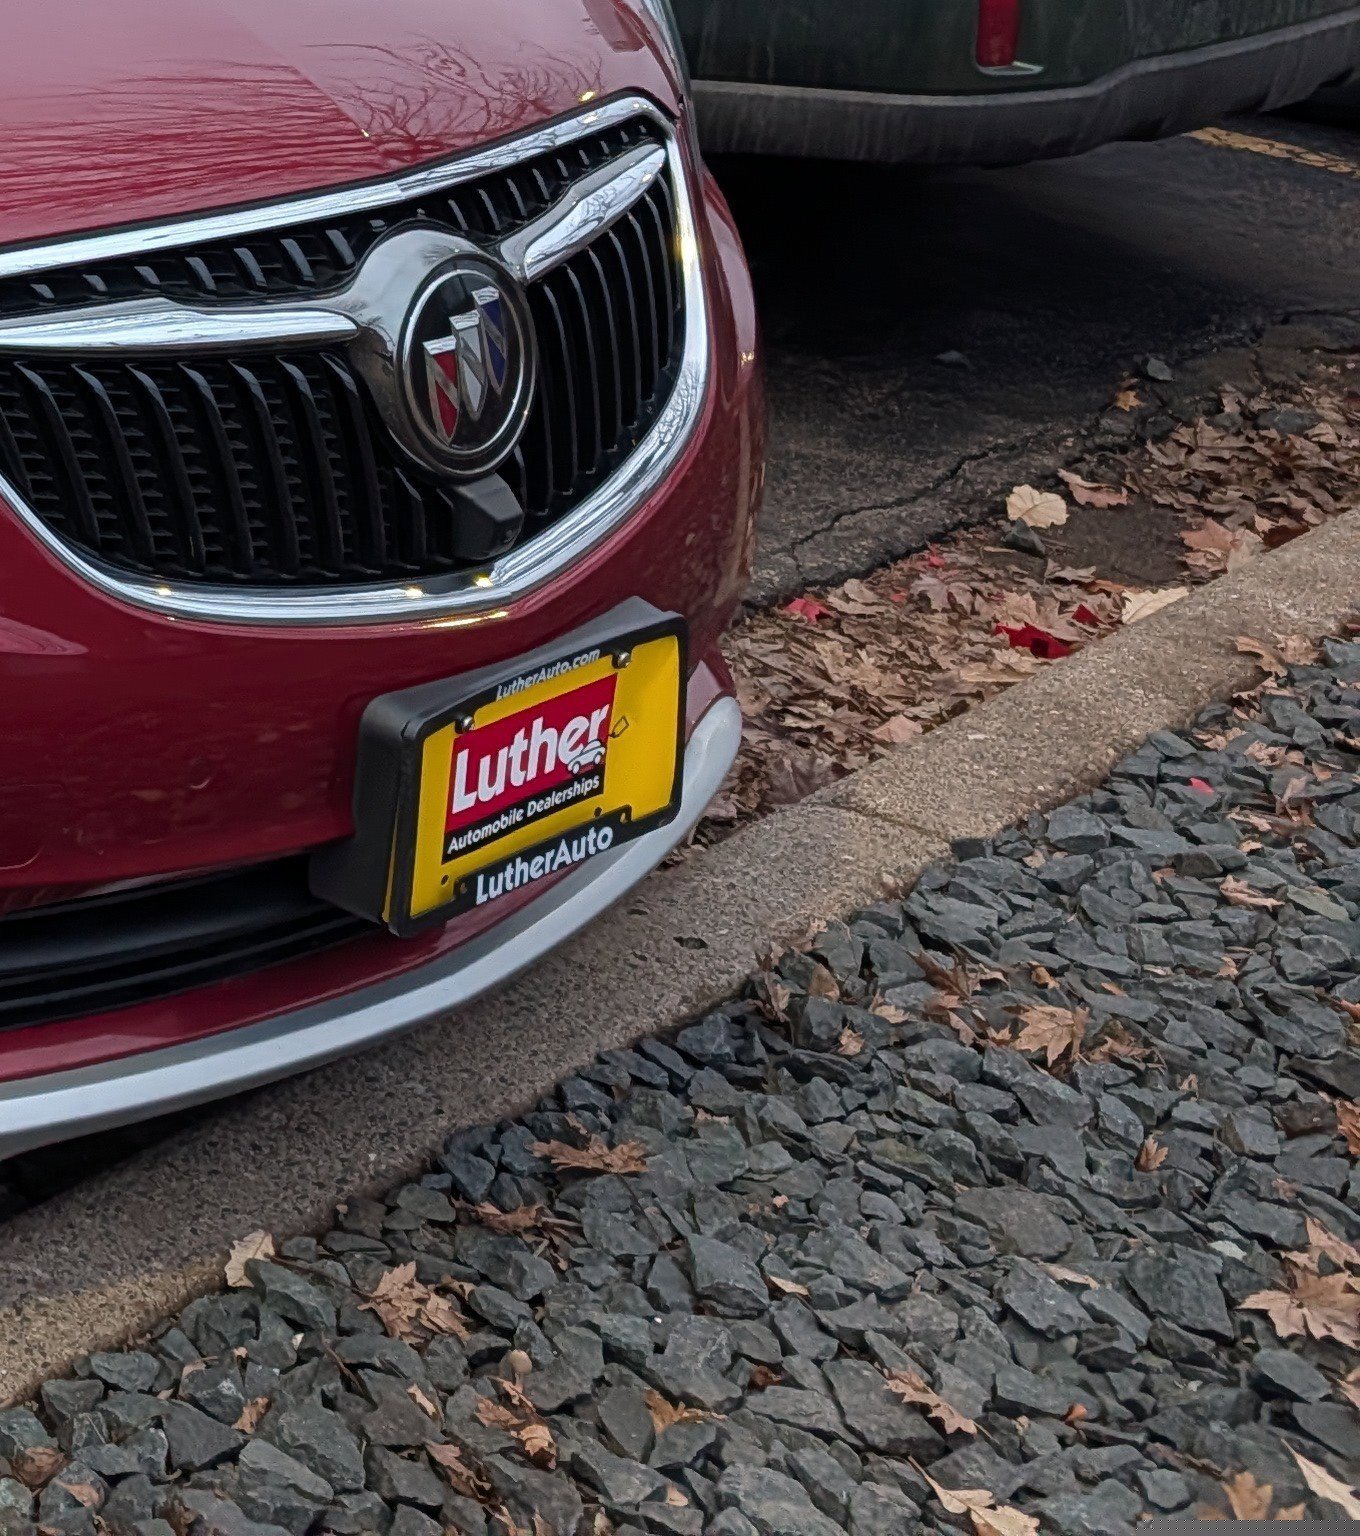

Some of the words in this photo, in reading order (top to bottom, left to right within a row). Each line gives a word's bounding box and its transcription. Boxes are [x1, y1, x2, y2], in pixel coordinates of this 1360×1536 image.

[496, 648, 601, 701] LutherAuto.com
[451, 703, 610, 815] Luther
[447, 807, 524, 855] Automobile
[526, 775, 600, 818] Dealerships
[476, 825, 614, 906] LutherAuto
